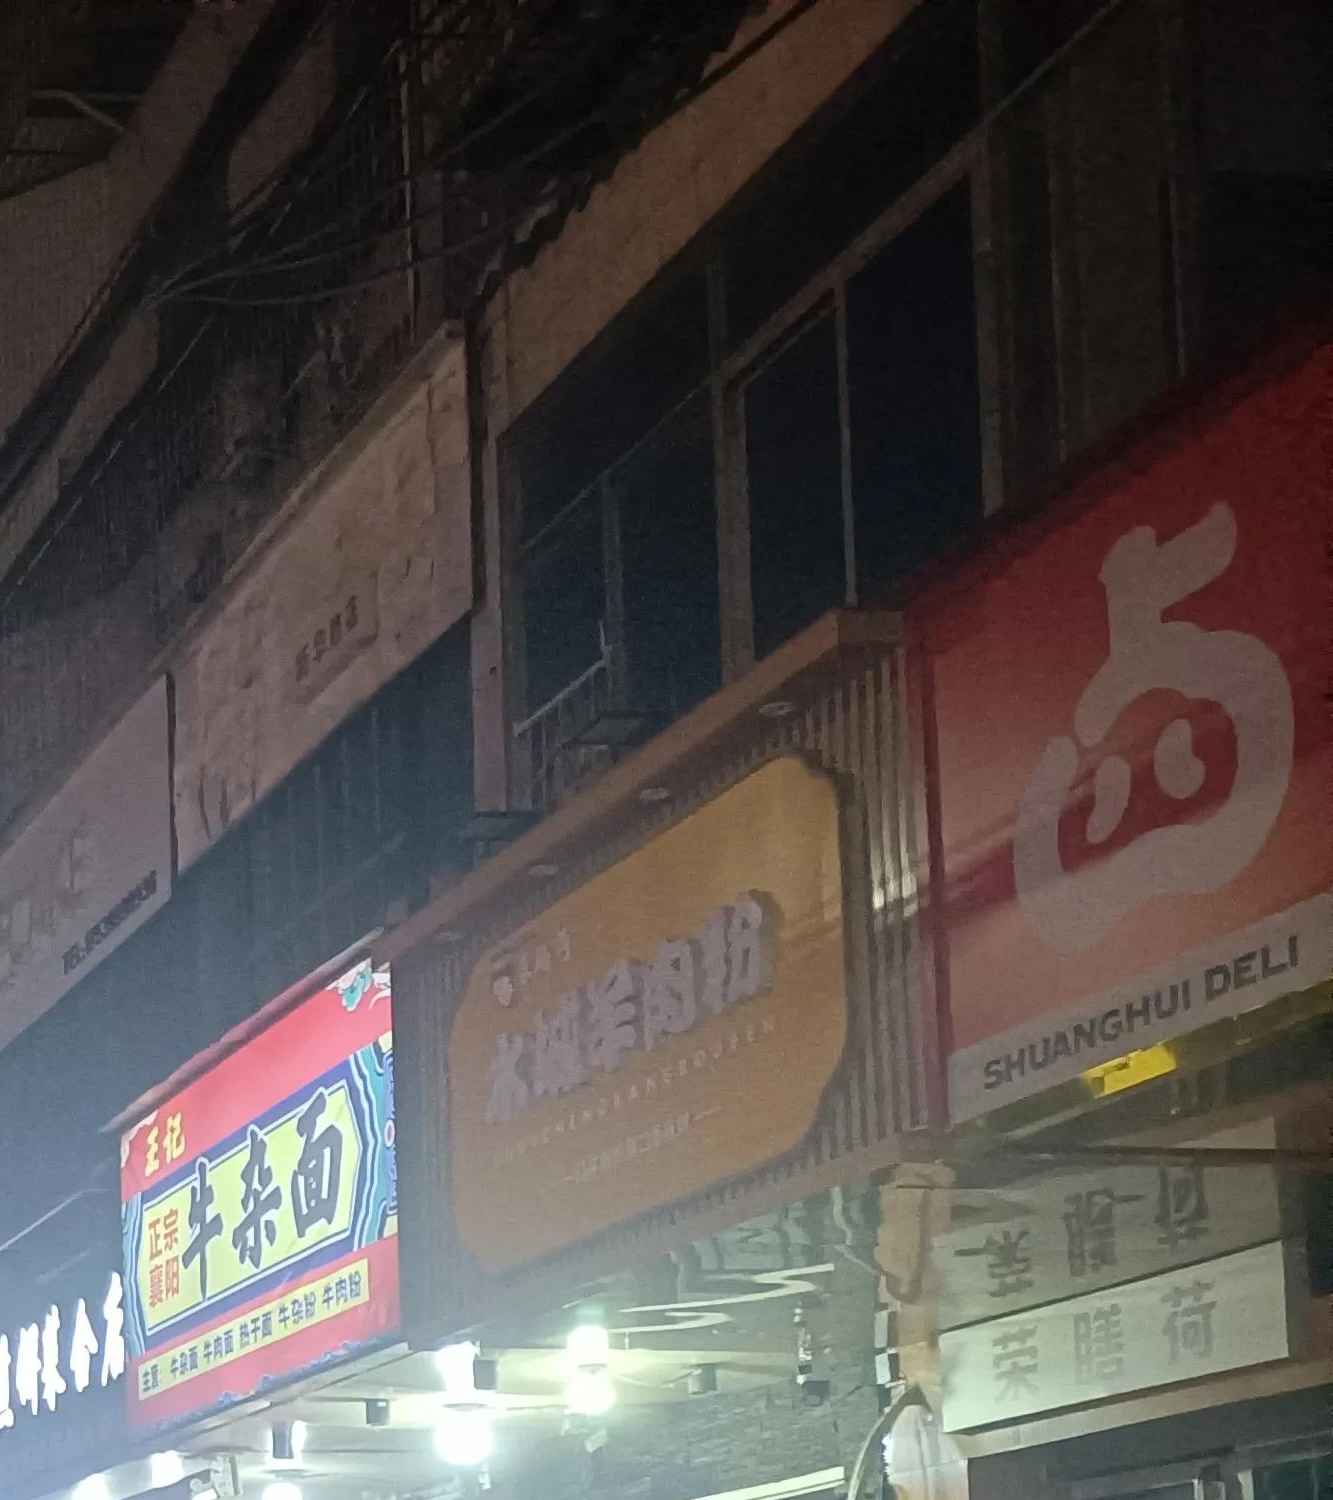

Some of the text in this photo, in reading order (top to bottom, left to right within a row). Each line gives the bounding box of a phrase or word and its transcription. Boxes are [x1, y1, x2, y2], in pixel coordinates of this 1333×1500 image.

[983, 934, 1299, 1090] SHUANGHUI DELI
[144, 1111, 187, 1177] 王记
[148, 1207, 180, 1262] 正宗
[182, 1086, 346, 1304] 牛杂面
[148, 1254, 181, 1309] 襄阳
[203, 1328, 234, 1365] 牛肉面
[239, 1311, 273, 1350] 热干面
[278, 1291, 317, 1329] 牛杂粉
[322, 1270, 362, 1312] 牛肉粉
